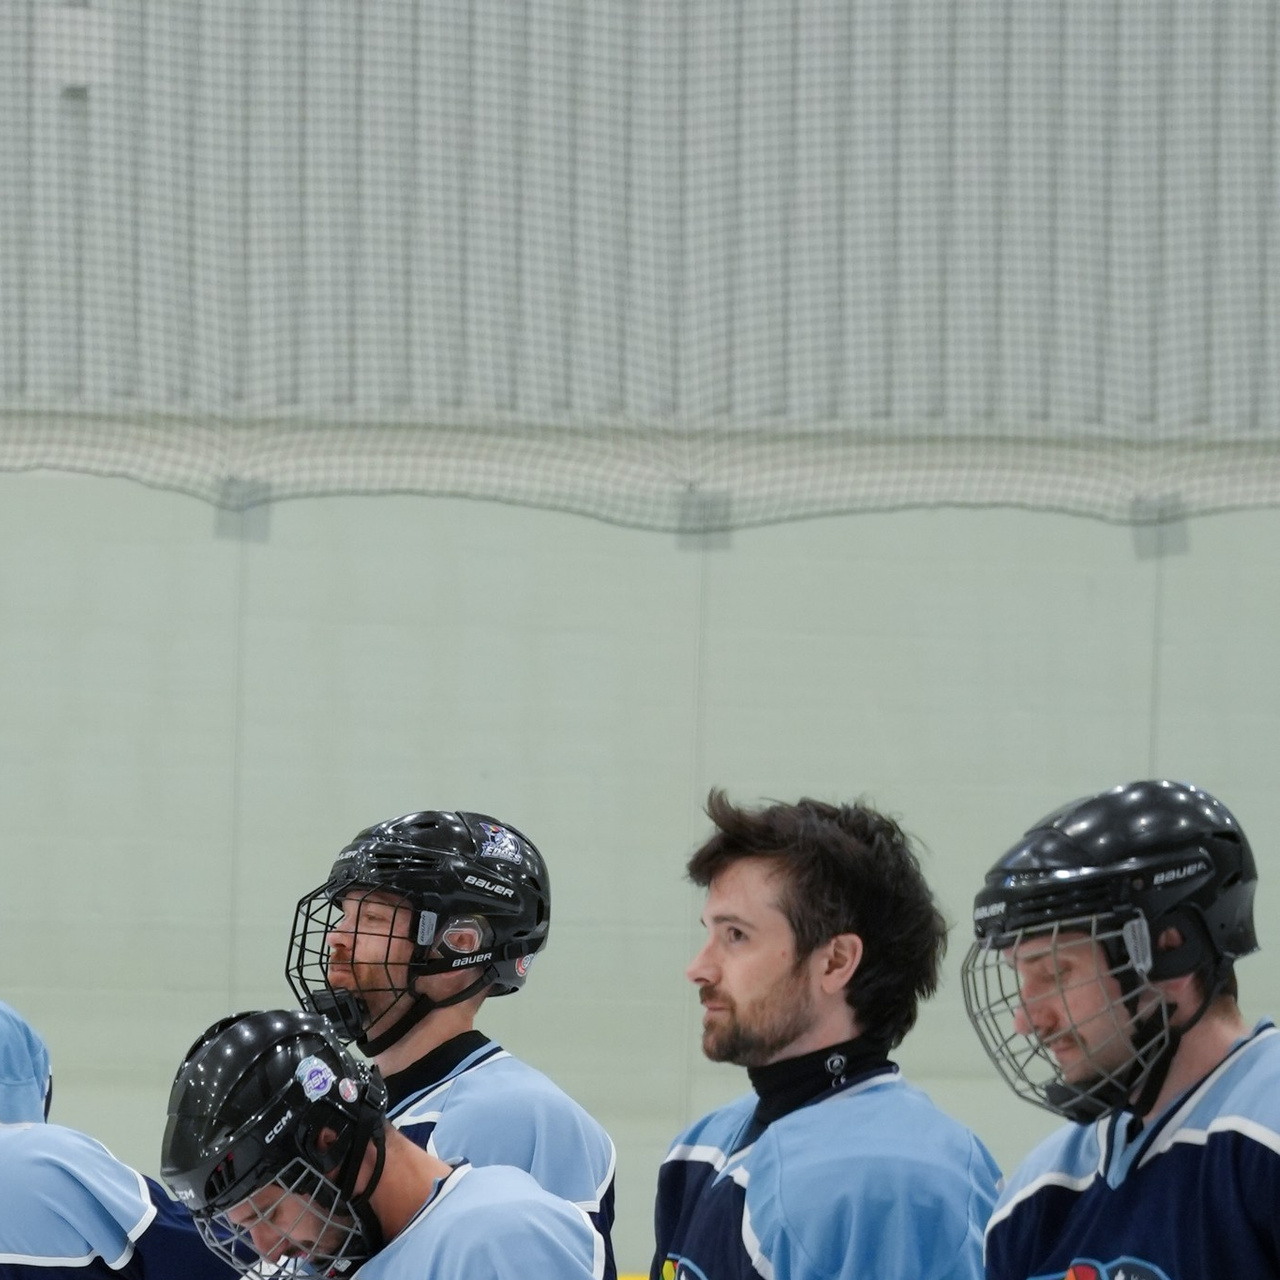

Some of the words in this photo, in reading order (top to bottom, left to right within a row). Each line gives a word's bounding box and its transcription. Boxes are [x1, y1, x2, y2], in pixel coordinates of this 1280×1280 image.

[1153, 861, 1207, 886] BAUER
[464, 875, 515, 898] BAUER
[451, 952, 493, 969] BAUER
[264, 1109, 293, 1145] CCM
